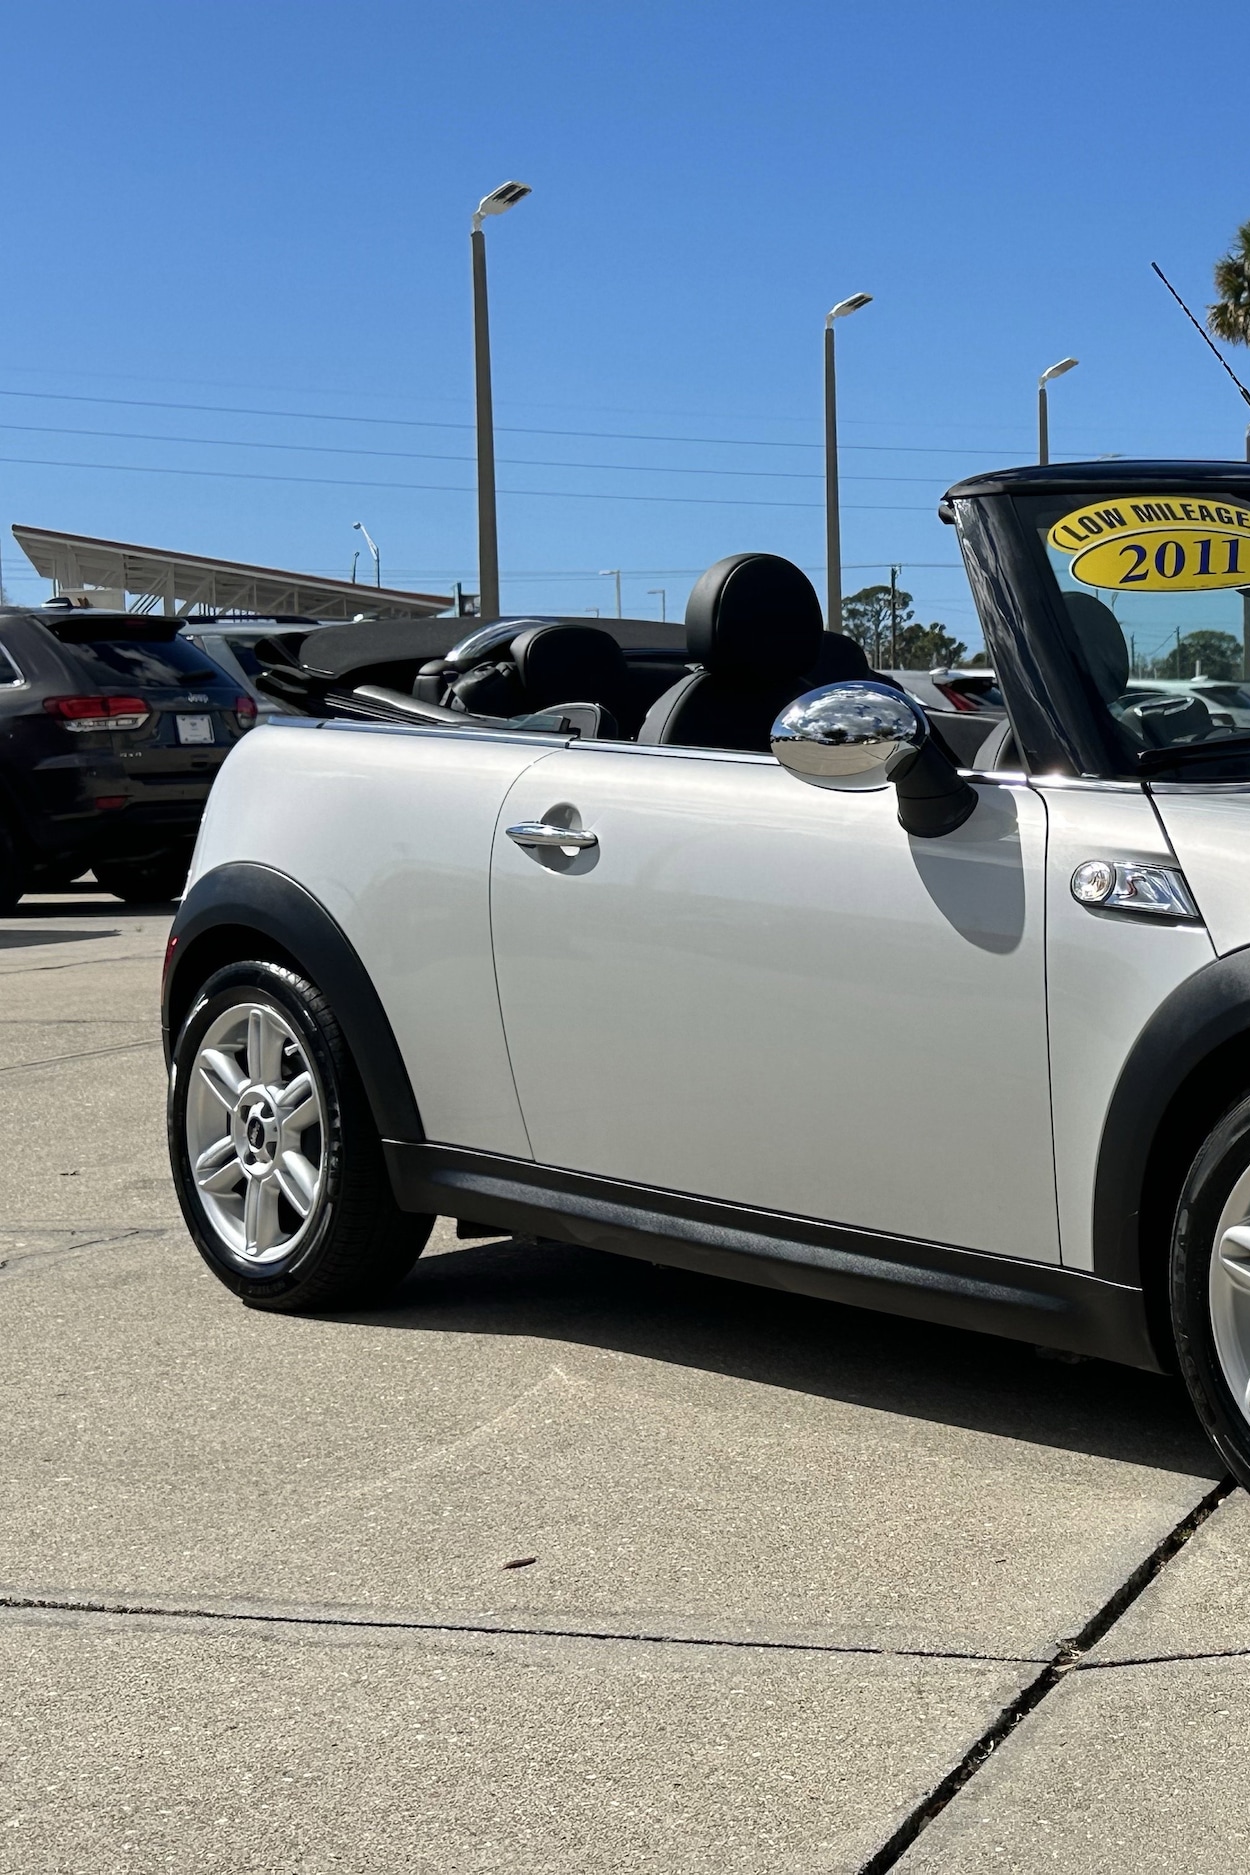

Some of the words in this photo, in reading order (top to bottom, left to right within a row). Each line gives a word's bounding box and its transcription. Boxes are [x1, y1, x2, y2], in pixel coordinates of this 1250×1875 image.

[1060, 507, 1128, 542] LOW
[1130, 503, 1250, 529] MILEAGE
[1118, 538, 1246, 584] 2011
